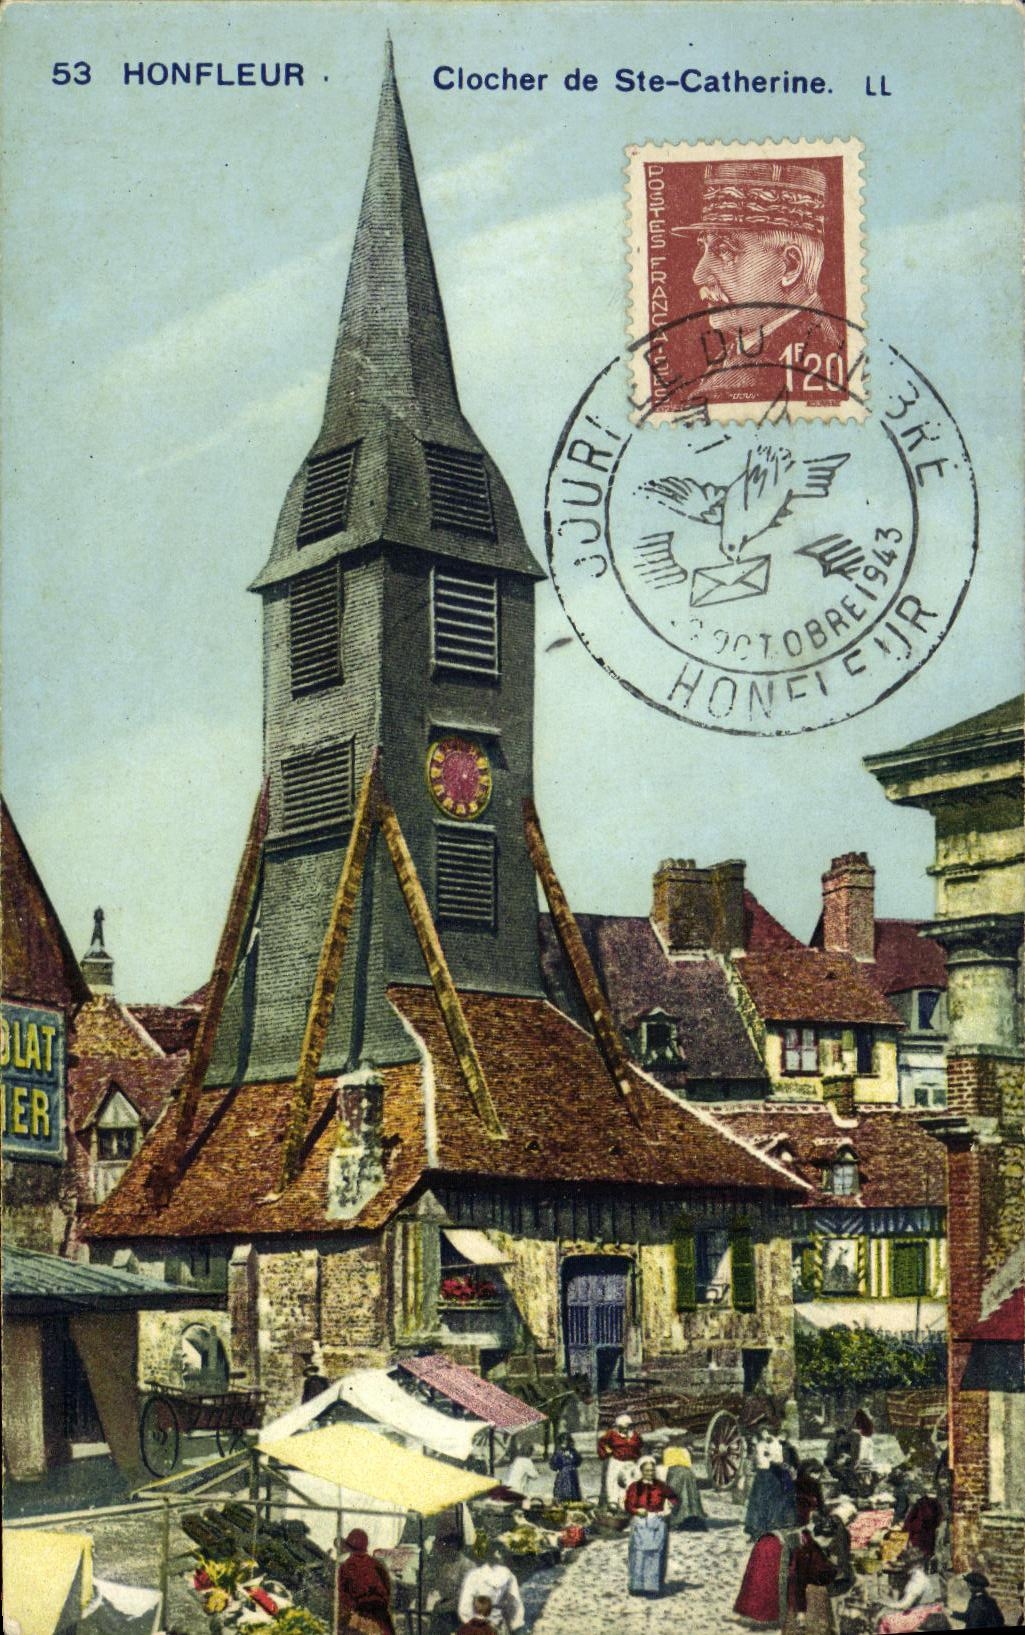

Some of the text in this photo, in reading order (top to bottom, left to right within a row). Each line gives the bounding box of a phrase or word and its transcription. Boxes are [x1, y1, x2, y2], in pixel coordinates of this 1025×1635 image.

[648, 165, 667, 247] POSTES
[700, 323, 764, 366] DU
[854, 527, 904, 602] 1943
